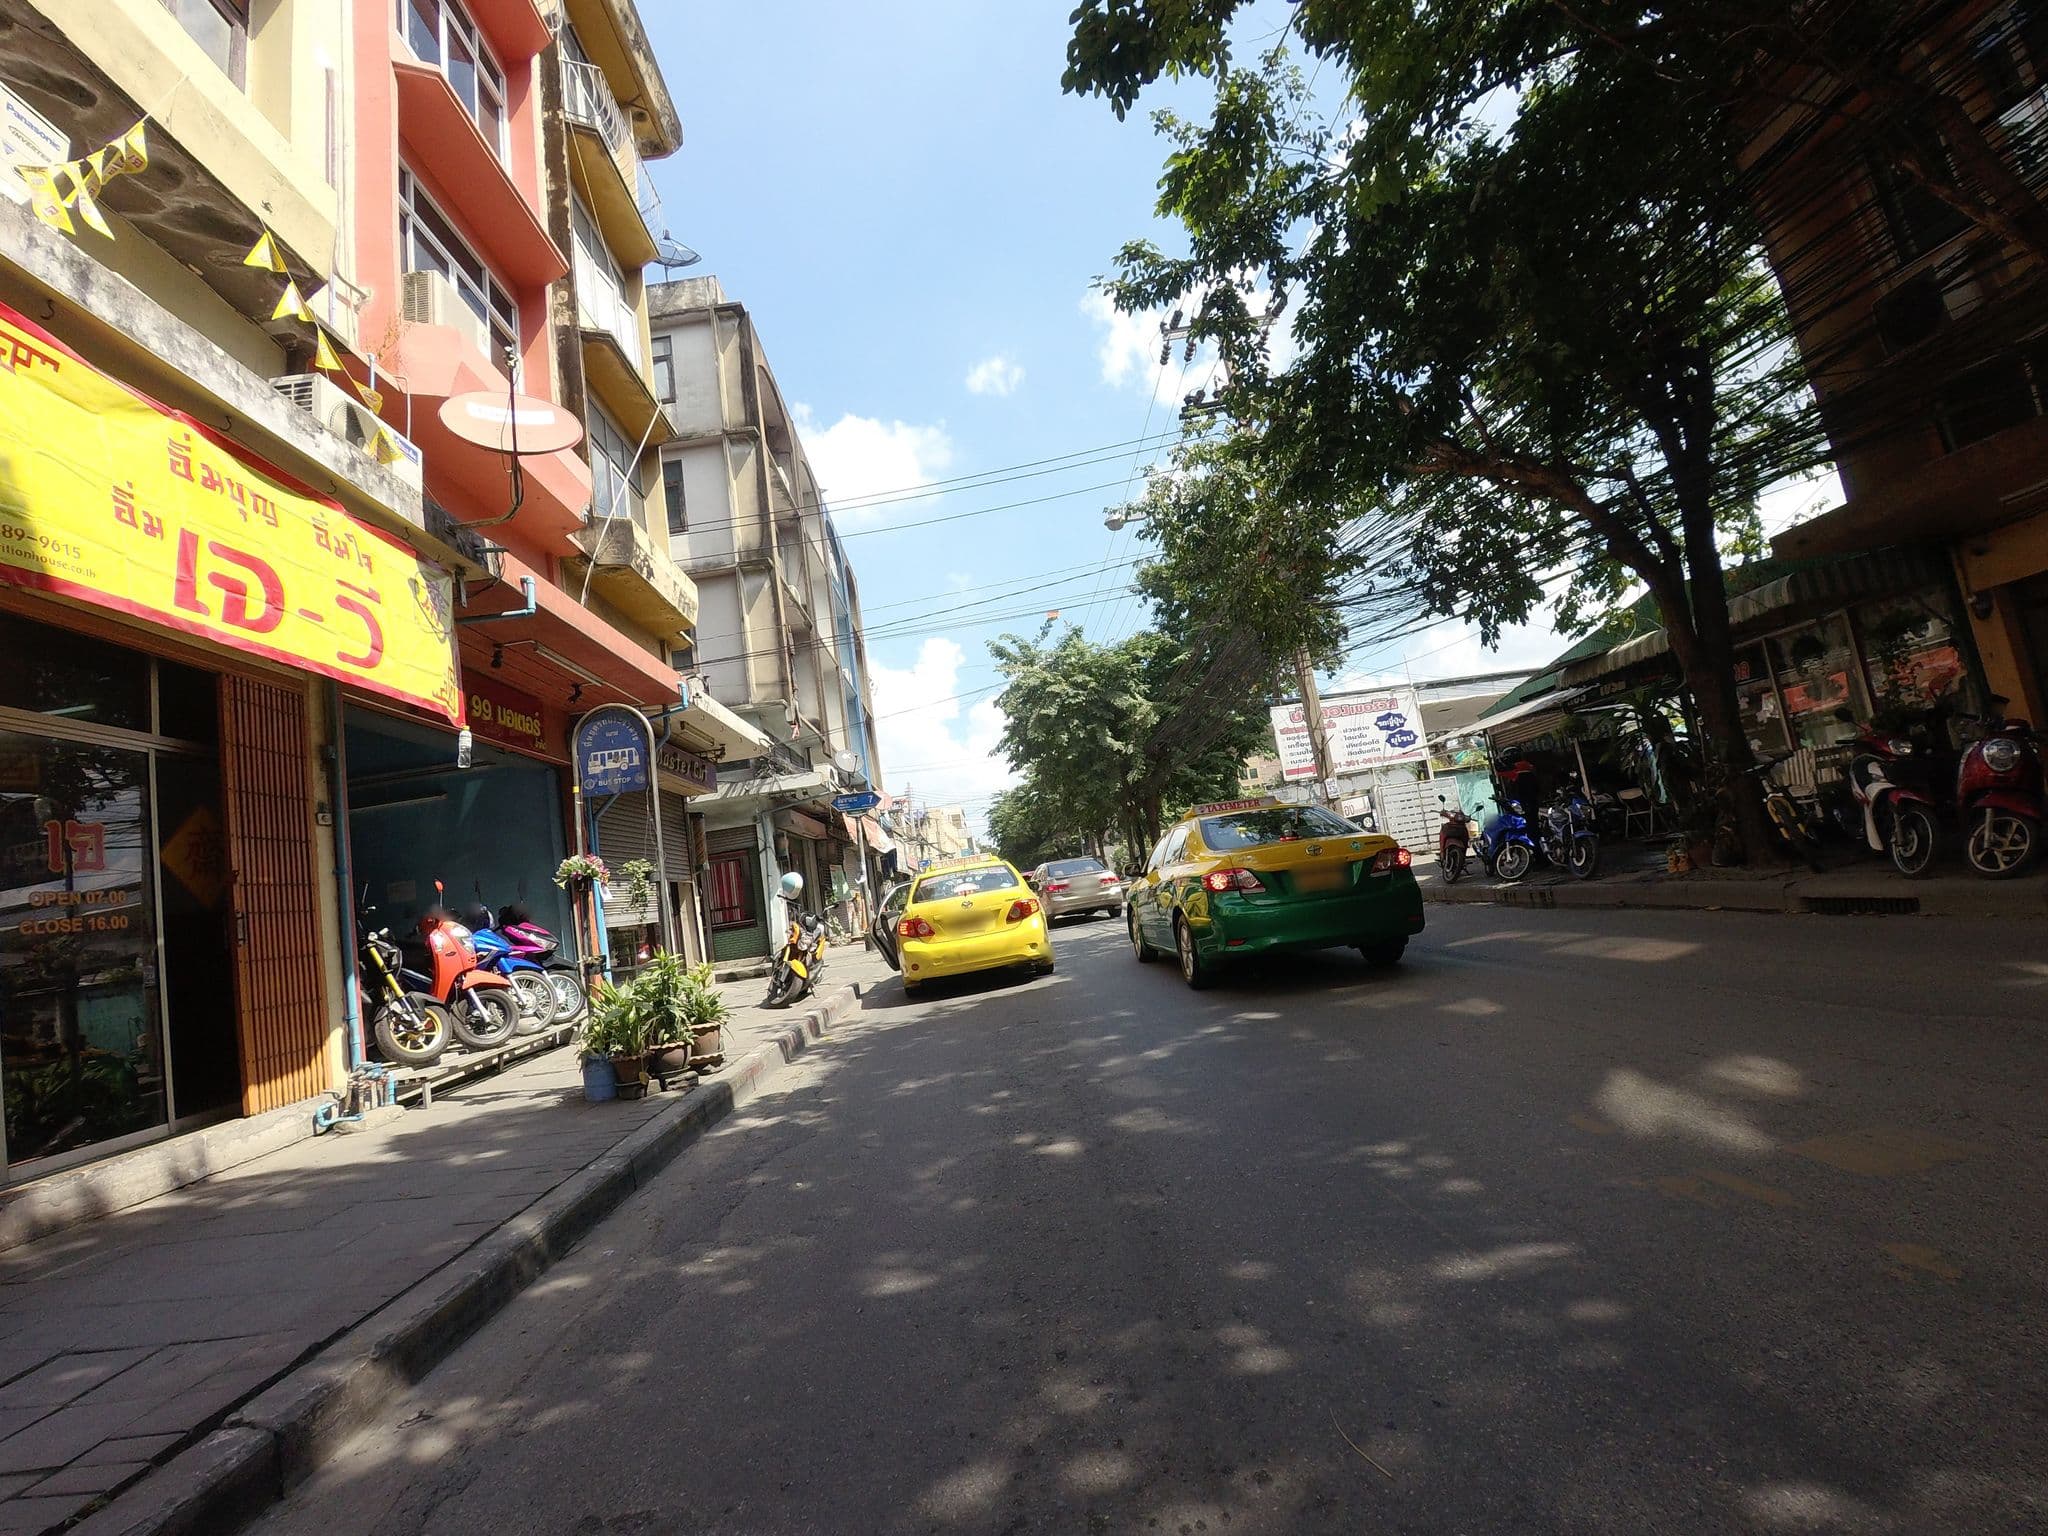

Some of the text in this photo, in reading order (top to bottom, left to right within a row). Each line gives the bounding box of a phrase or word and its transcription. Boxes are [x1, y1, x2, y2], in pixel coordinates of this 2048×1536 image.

[6, 101, 61, 152] Panasonic
[112, 480, 164, 541] อิ่ม
[167, 432, 374, 575] อิ่มบุญ อิ่มใจ
[470, 693, 492, 721] 99
[867, 795, 873, 804] 7
[1205, 799, 1261, 813] TAXI-METER
[28, 891, 81, 908] OPEN
[19, 915, 129, 935] CLOSE 16.00
